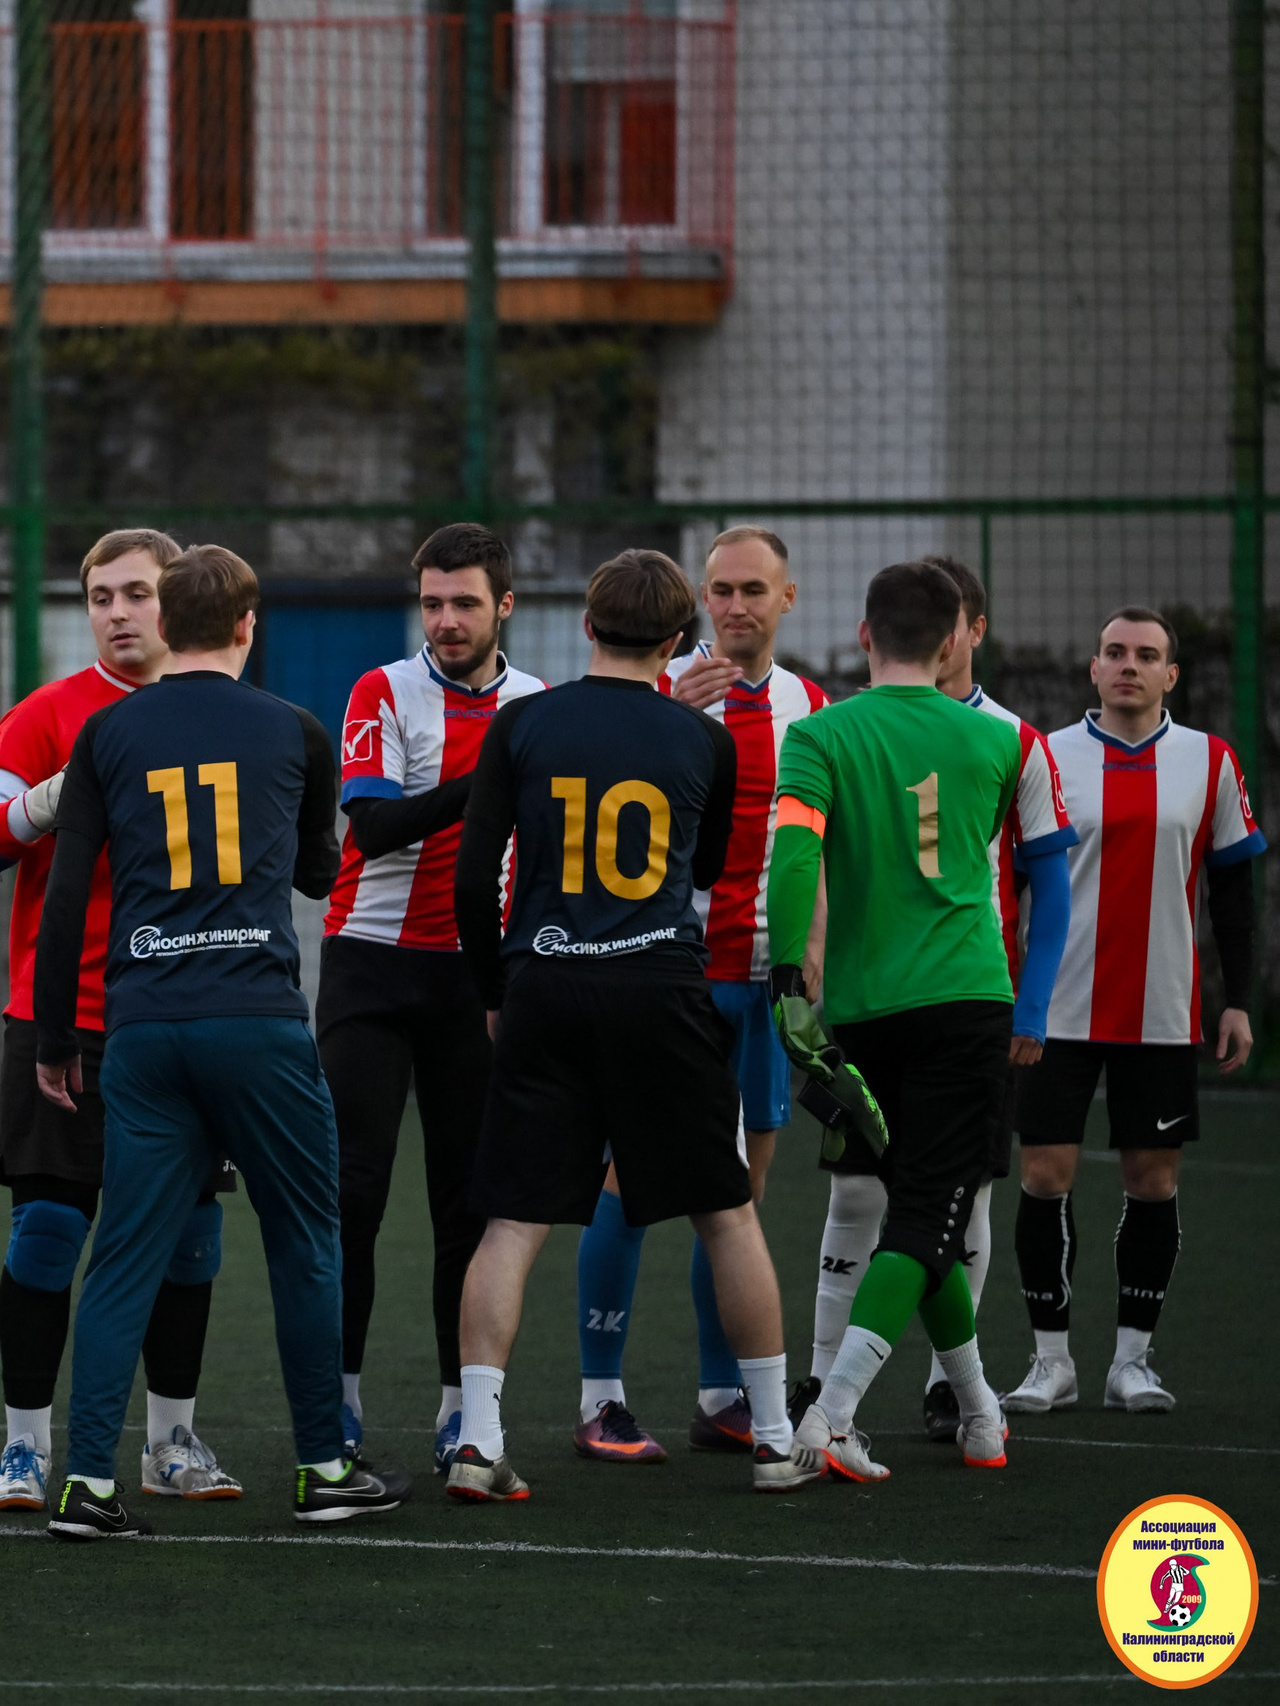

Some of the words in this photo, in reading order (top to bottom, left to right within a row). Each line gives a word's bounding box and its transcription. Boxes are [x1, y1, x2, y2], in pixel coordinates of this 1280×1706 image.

[146, 761, 242, 891] 11
[551, 777, 671, 900] 10
[906, 772, 945, 878] 1
[821, 1255, 858, 1275] 2K
[586, 1308, 626, 1334] 2K
